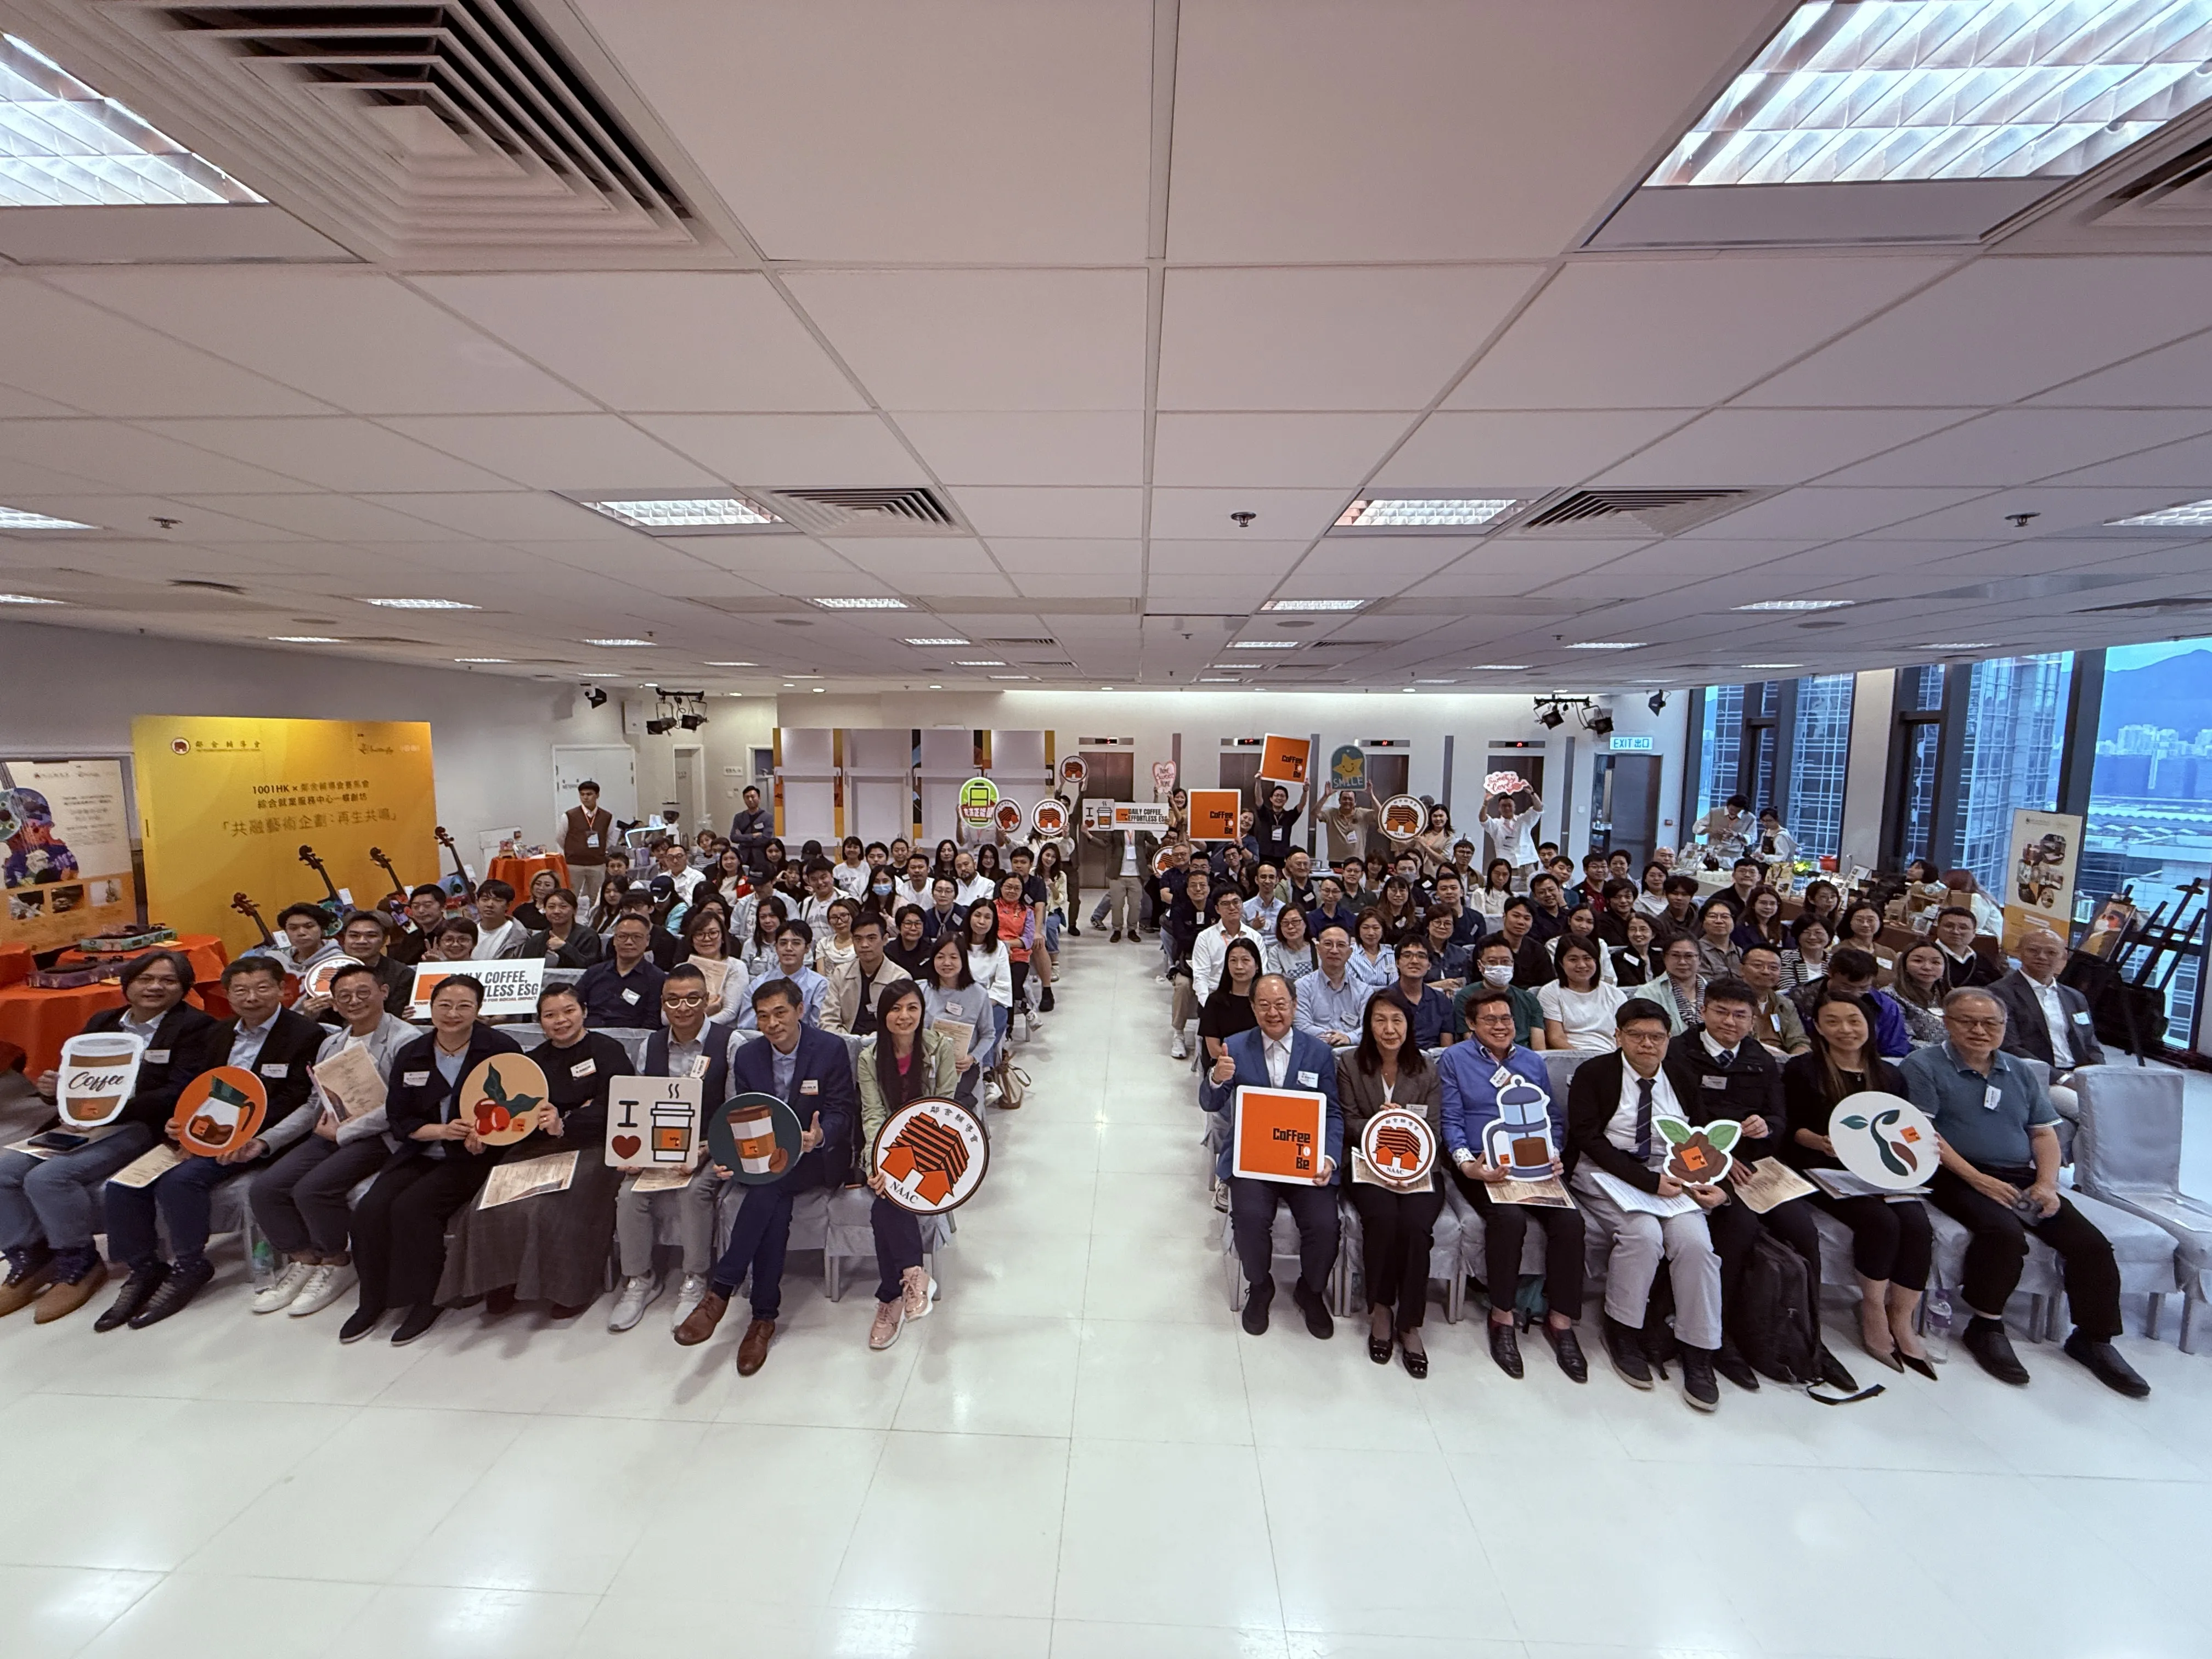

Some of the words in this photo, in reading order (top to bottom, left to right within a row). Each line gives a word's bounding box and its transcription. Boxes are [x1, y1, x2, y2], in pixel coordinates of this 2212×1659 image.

[1613, 738, 1633, 748] EXIT
[1634, 738, 1650, 748] 出口
[1333, 777, 1364, 788] SMILE
[253, 785, 289, 794] 1001HK
[1086, 807, 1093, 817] I
[484, 970, 528, 984] COFFEE,
[517, 983, 539, 996] ESG
[68, 1071, 125, 1092] Coffee
[617, 1100, 640, 1128] I
[1296, 1156, 1310, 1170] Be
[1386, 1166, 1405, 1175] NAAC
[889, 1181, 919, 1204] NAAC
